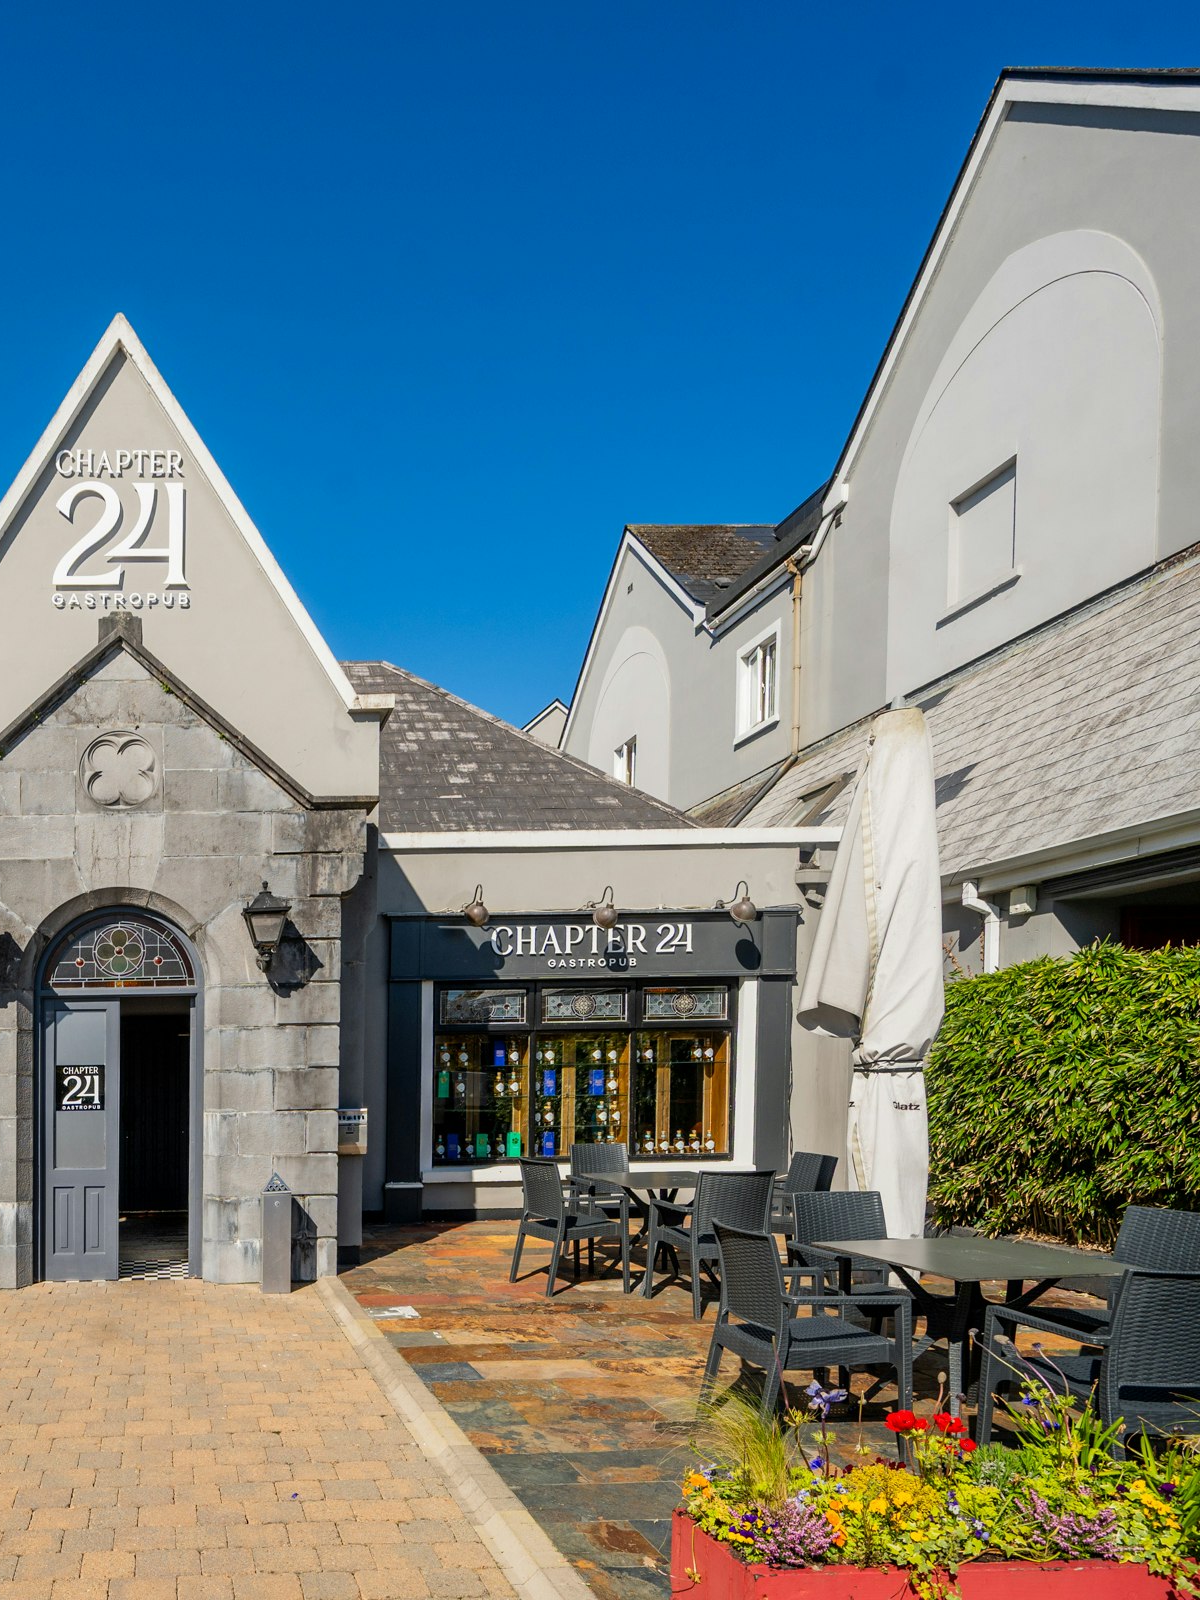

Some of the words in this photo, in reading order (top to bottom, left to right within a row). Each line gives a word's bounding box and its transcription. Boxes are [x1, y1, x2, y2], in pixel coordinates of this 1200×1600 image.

[55, 449, 183, 476] CHAPTER
[52, 481, 188, 586] 24
[52, 592, 188, 606] GASTROPUB
[491, 924, 648, 956] CHAPTER
[655, 923, 694, 954] 24
[547, 958, 637, 969] GASTROPUB
[62, 1066, 99, 1075] CHAPTER
[62, 1075, 101, 1105] 24
